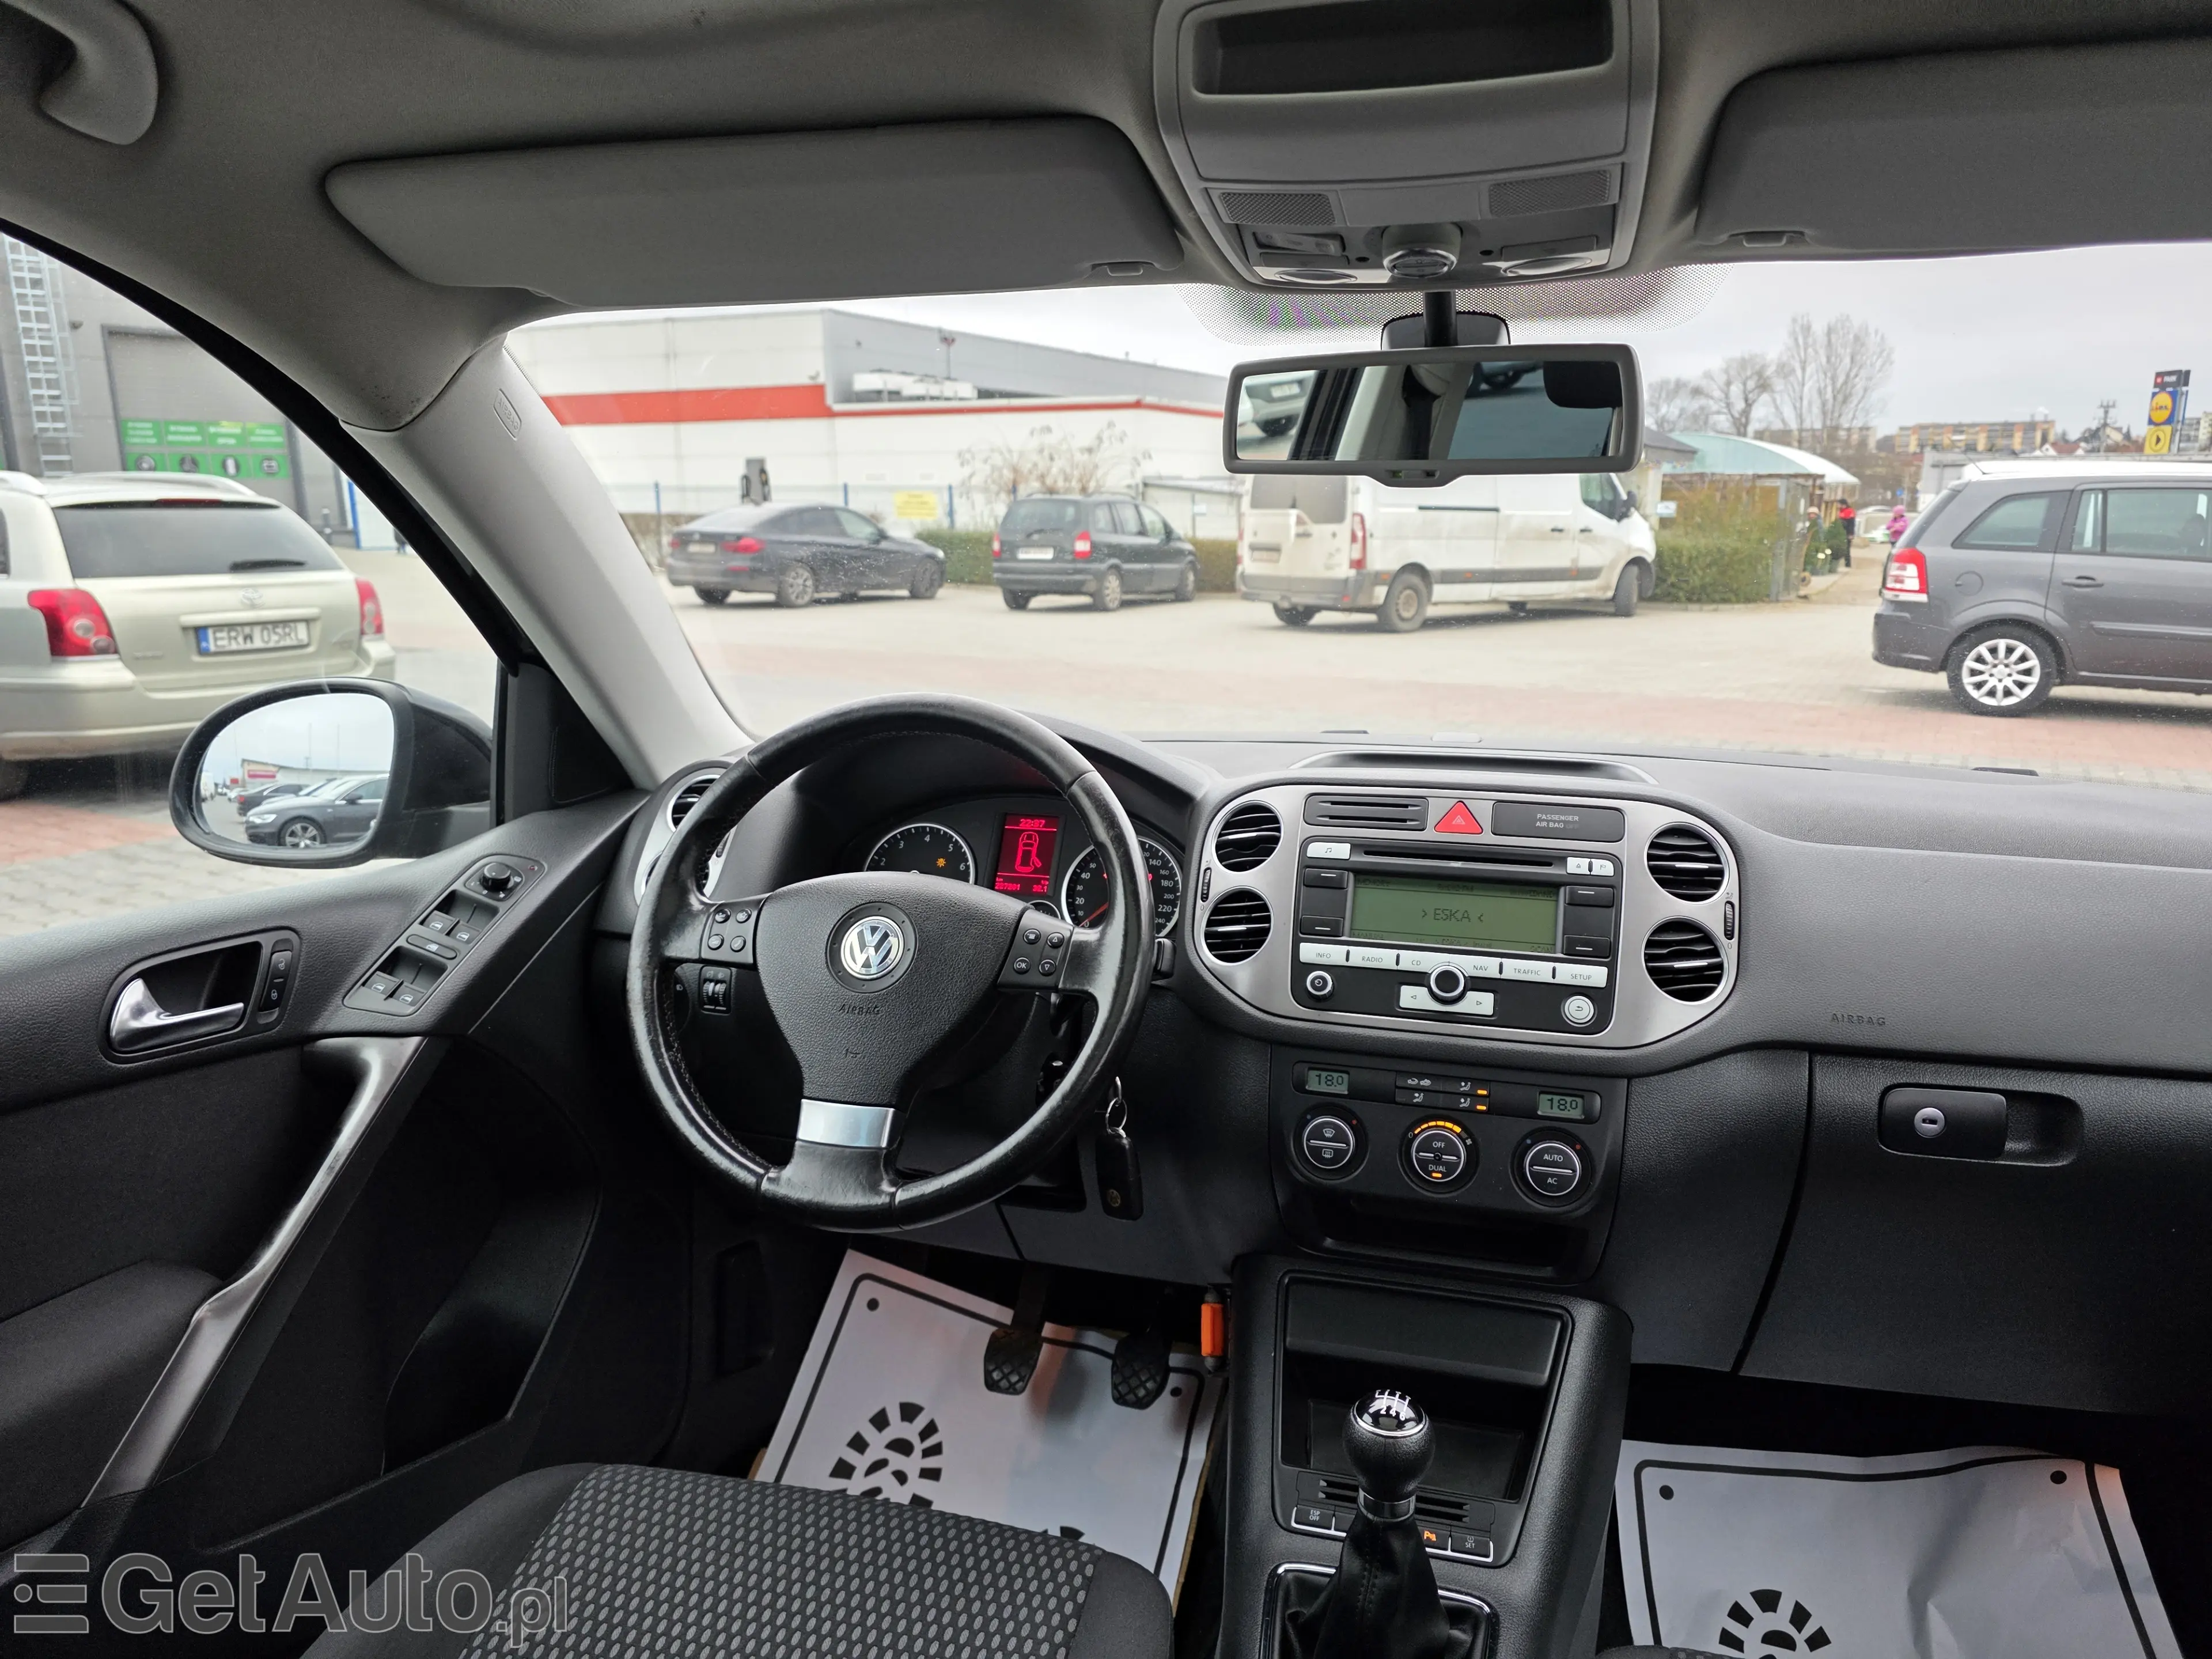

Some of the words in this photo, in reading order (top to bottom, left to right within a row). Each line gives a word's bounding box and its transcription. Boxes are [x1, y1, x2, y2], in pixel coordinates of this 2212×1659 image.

[498, 397, 519, 431] AIRBAG
[213, 625, 253, 649] ERW
[1536, 813, 1579, 821] PASSENGER
[924, 834, 930, 843] 4
[899, 840, 904, 849] 3
[948, 843, 954, 852] 5
[880, 858, 886, 866] 2
[960, 862, 965, 870] 6
[1149, 858, 1162, 866] 140
[1161, 879, 1174, 888] 180
[1157, 904, 1172, 912] 220
[1433, 908, 1471, 922] ESKA
[1513, 968, 1541, 976] TRAFFIC
[1570, 973, 1592, 981] SETUP
[838, 1002, 881, 1015] AIRBAG
[1831, 1013, 1886, 1026] AIRBAG
[1315, 1073, 1344, 1088] 18.0
[1547, 1097, 1578, 1112] 18.0
[1543, 1153, 1564, 1162] AUTO
[1428, 1164, 1447, 1172] DUAL
[1380, 1406, 1387, 1415] 2
[1389, 1407, 1396, 1417] 4
[1399, 1411, 1406, 1421] 6
[1465, 1541, 1476, 1550] SET
